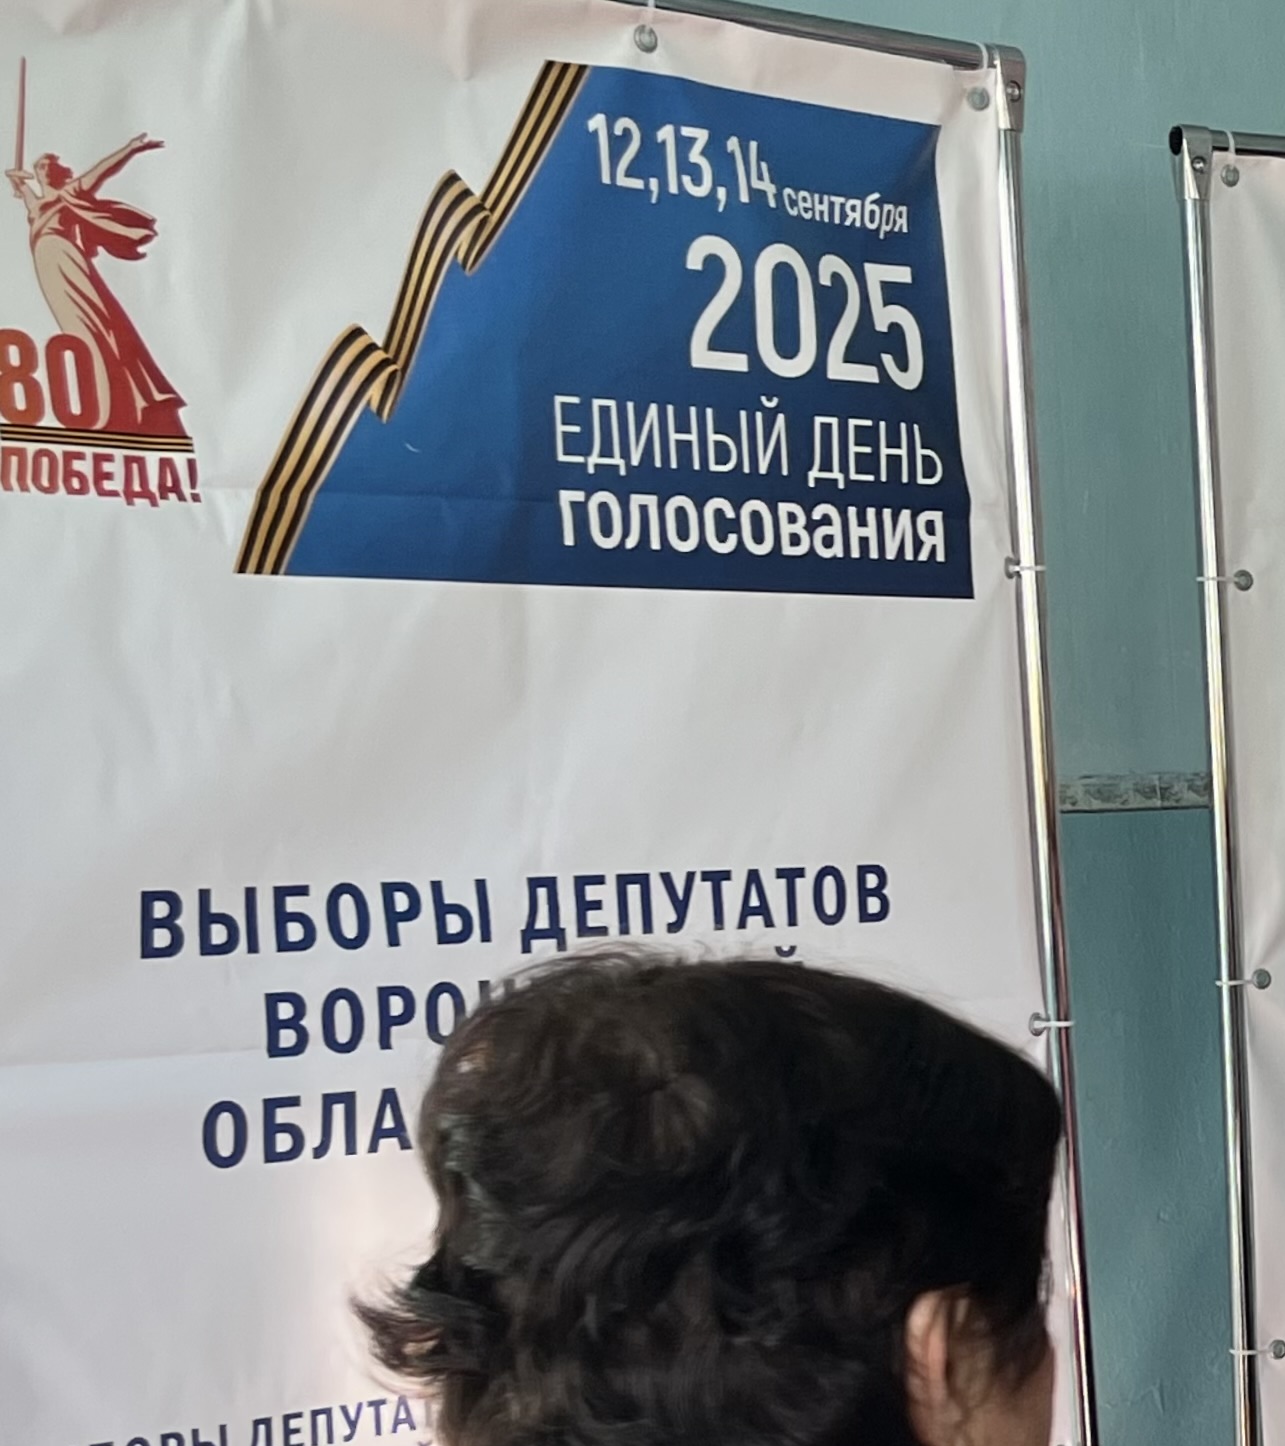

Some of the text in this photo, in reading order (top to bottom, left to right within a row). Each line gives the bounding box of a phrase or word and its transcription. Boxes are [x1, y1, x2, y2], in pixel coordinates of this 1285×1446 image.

[783, 192, 909, 240] сентября
[686, 235, 924, 391] 2025
[0, 328, 101, 430] 80
[1, 446, 202, 507] ПОБЕДА!
[554, 395, 944, 489] ЕДИНЫЙ ДЕНЬ
[139, 864, 891, 960] ВЫБОРЫ ДЕПУТАТОВ
